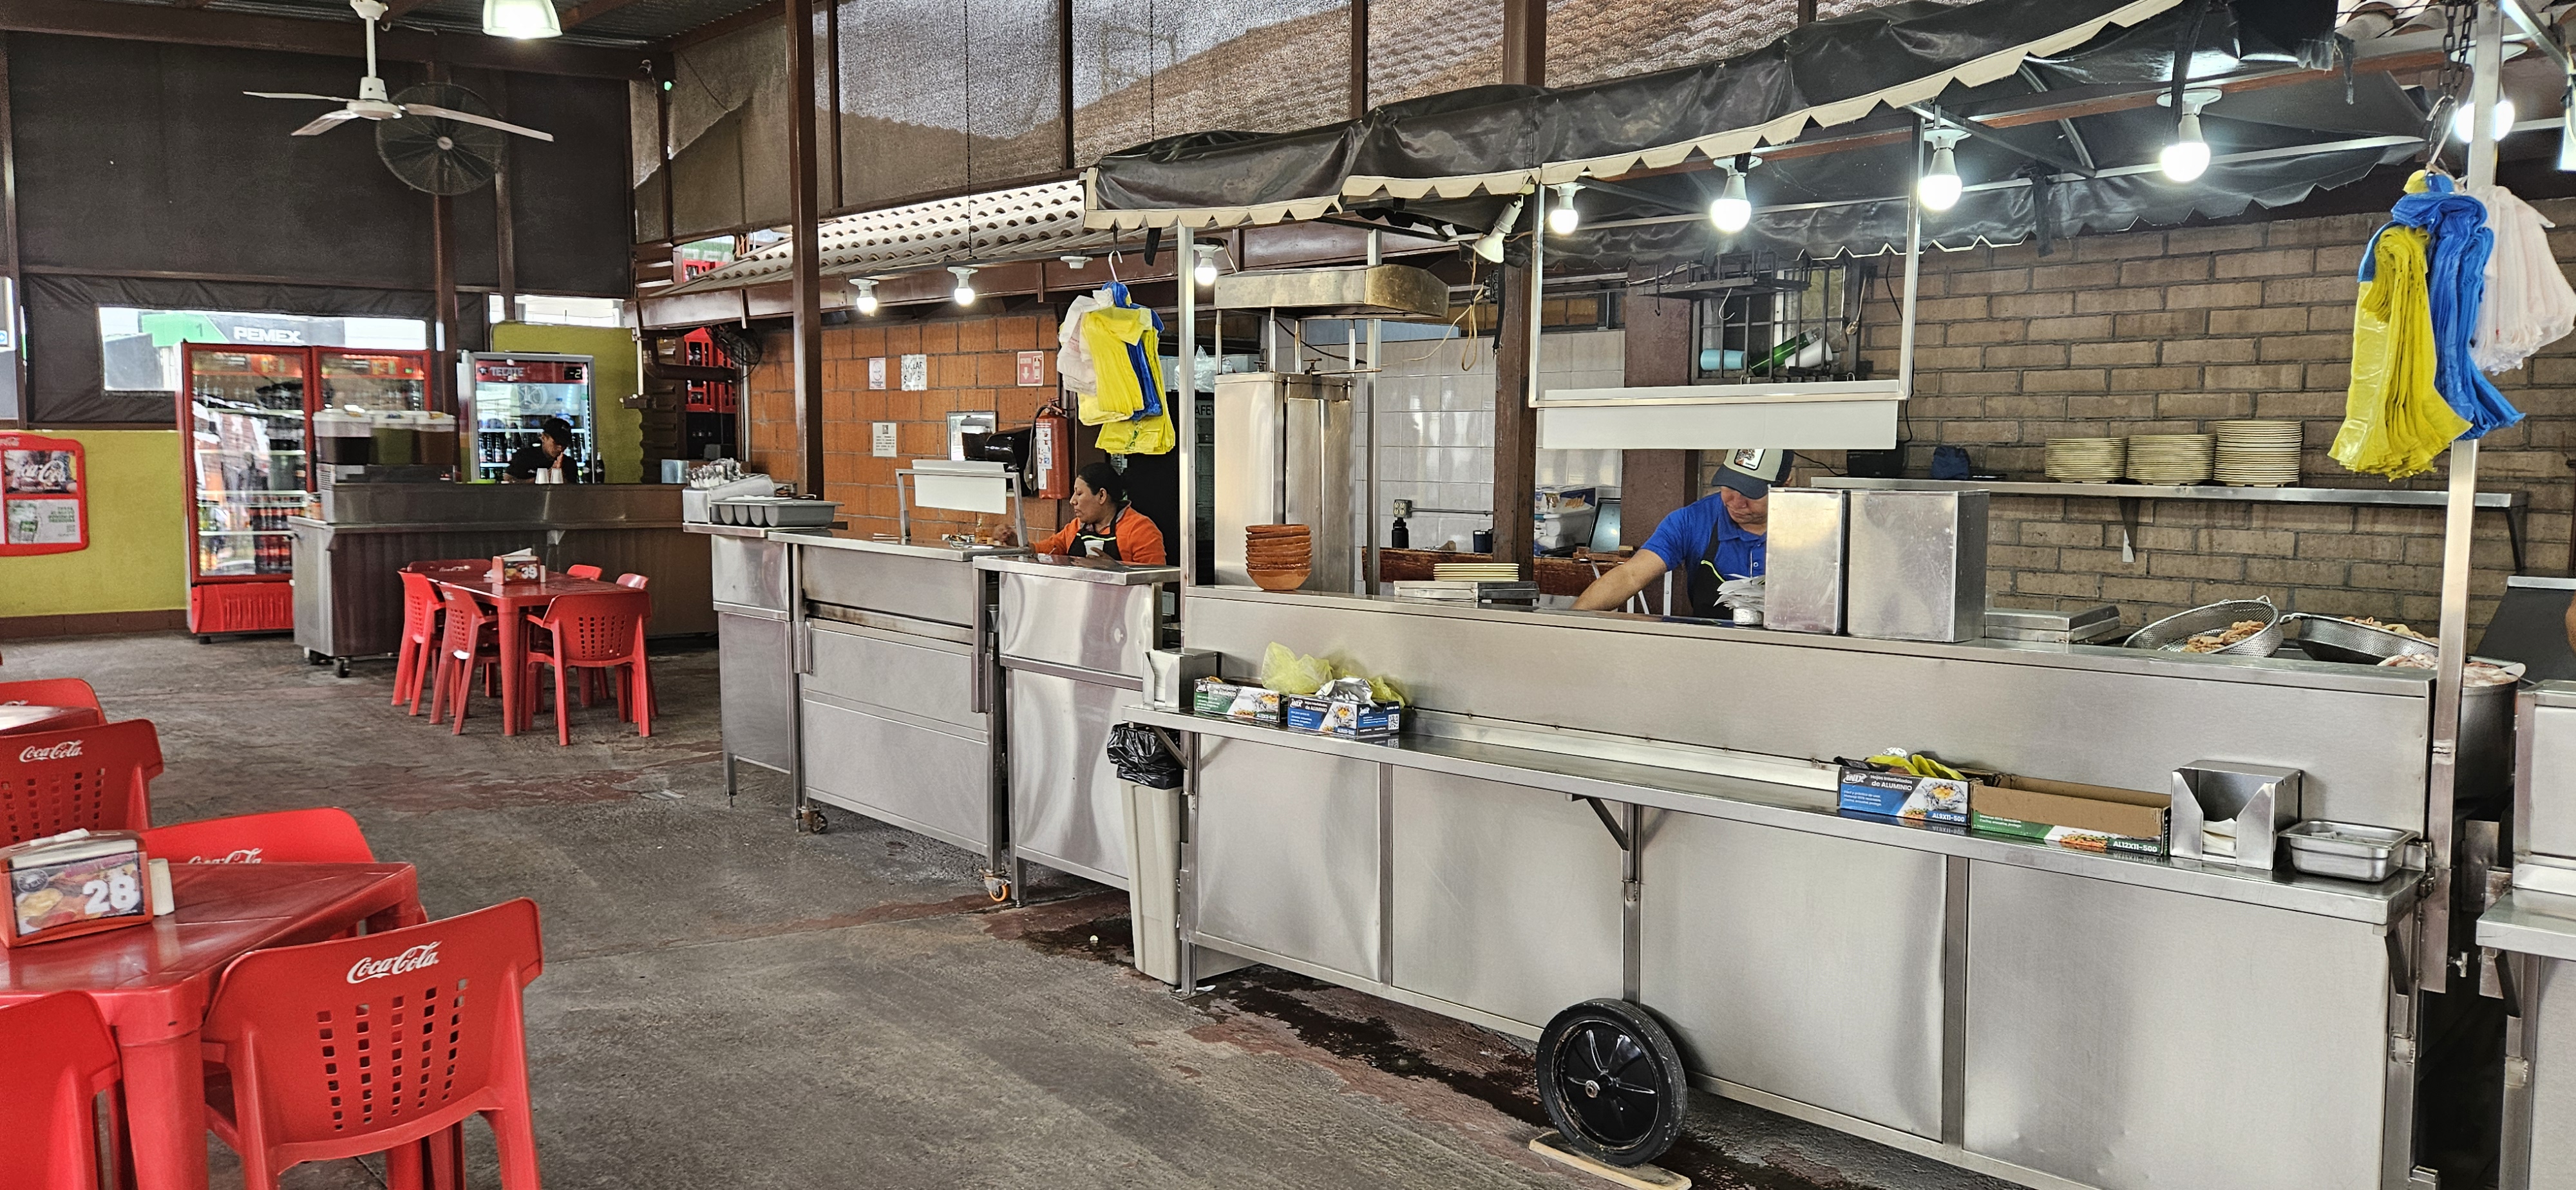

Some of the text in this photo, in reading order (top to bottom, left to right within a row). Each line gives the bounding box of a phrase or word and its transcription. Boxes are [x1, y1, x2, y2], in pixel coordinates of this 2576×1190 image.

[234, 326, 302, 343] PEMEX
[490, 366, 524, 377] TECATE
[521, 567, 538, 579] 39
[19, 739, 84, 762] Coca-Cola
[1881, 782, 1913, 791] ALUMINIO
[82, 871, 141, 915] 28
[346, 940, 442, 984] Coca-Cola
